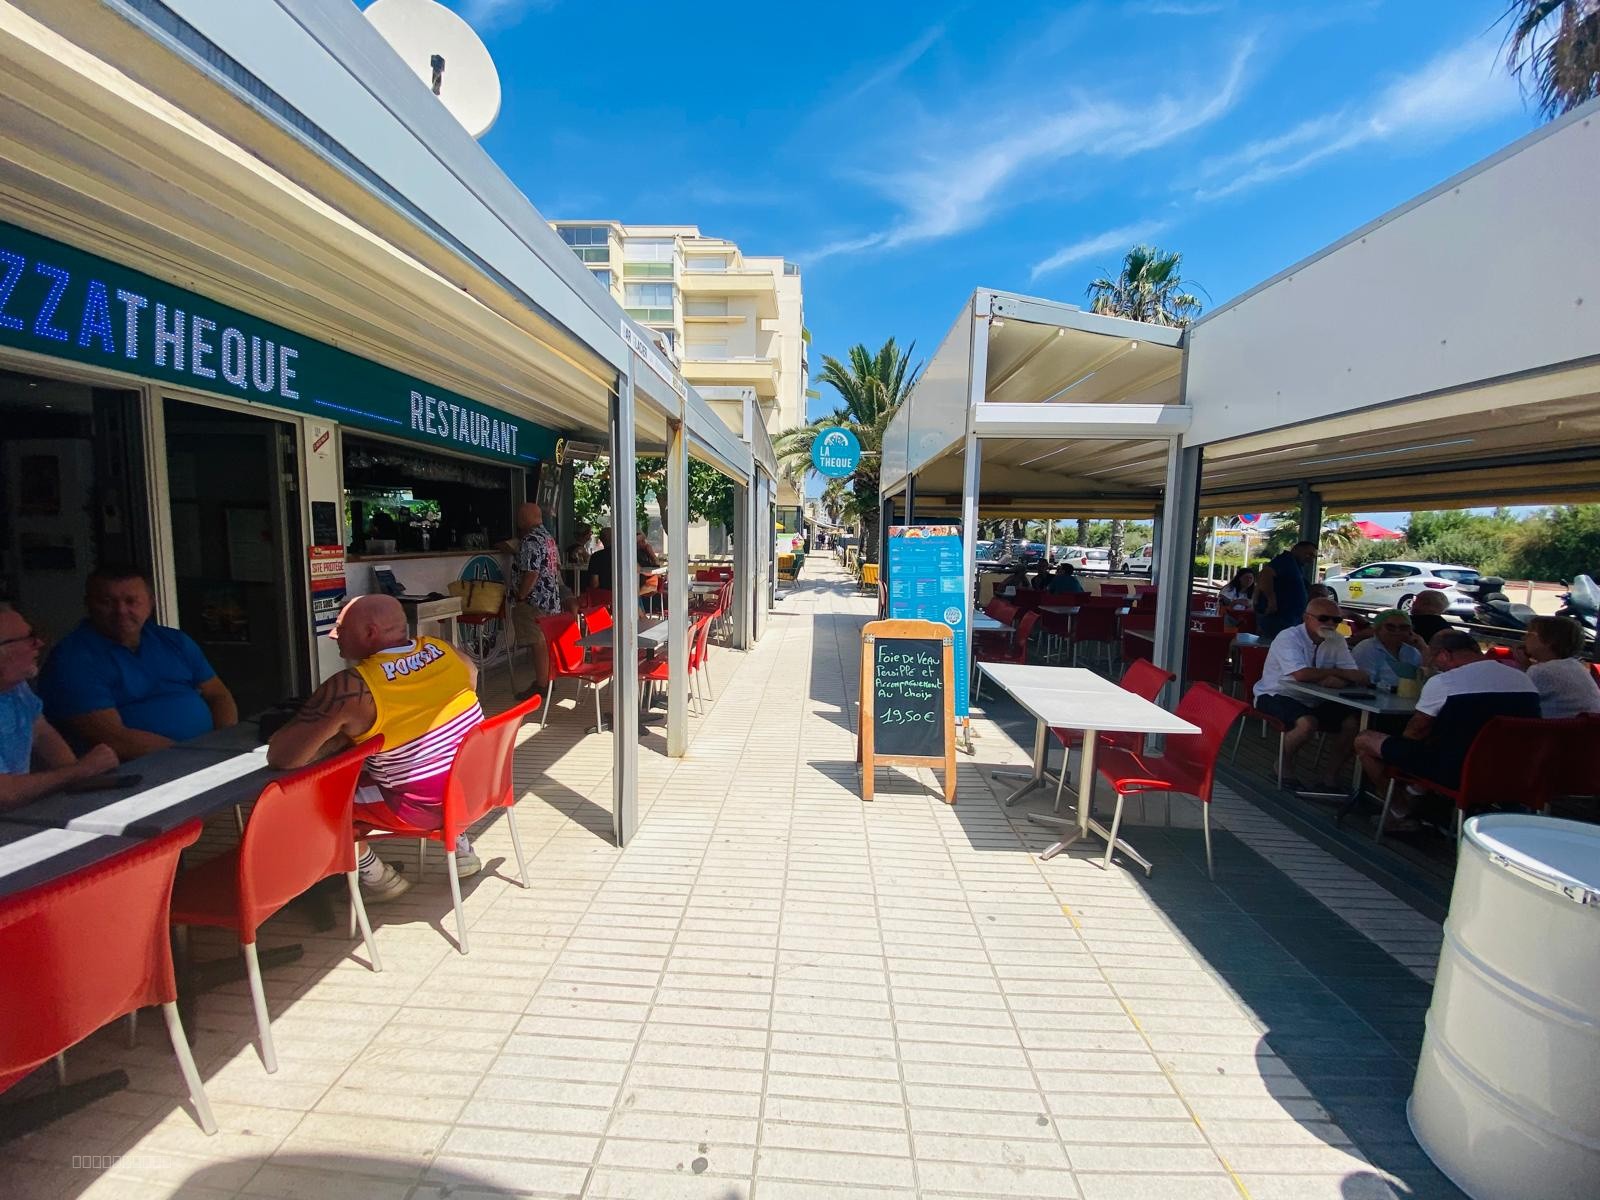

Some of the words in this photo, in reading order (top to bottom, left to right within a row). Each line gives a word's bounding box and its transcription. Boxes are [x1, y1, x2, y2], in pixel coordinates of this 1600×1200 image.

[410, 390, 518, 456] RESTAURANT
[820, 446, 830, 456] LA
[820, 457, 852, 468] THEQUE
[878, 645, 900, 663] Foie
[901, 654, 914, 664] De
[921, 665, 935, 677] et
[878, 689, 893, 698] Au
[904, 687, 933, 701] choix
